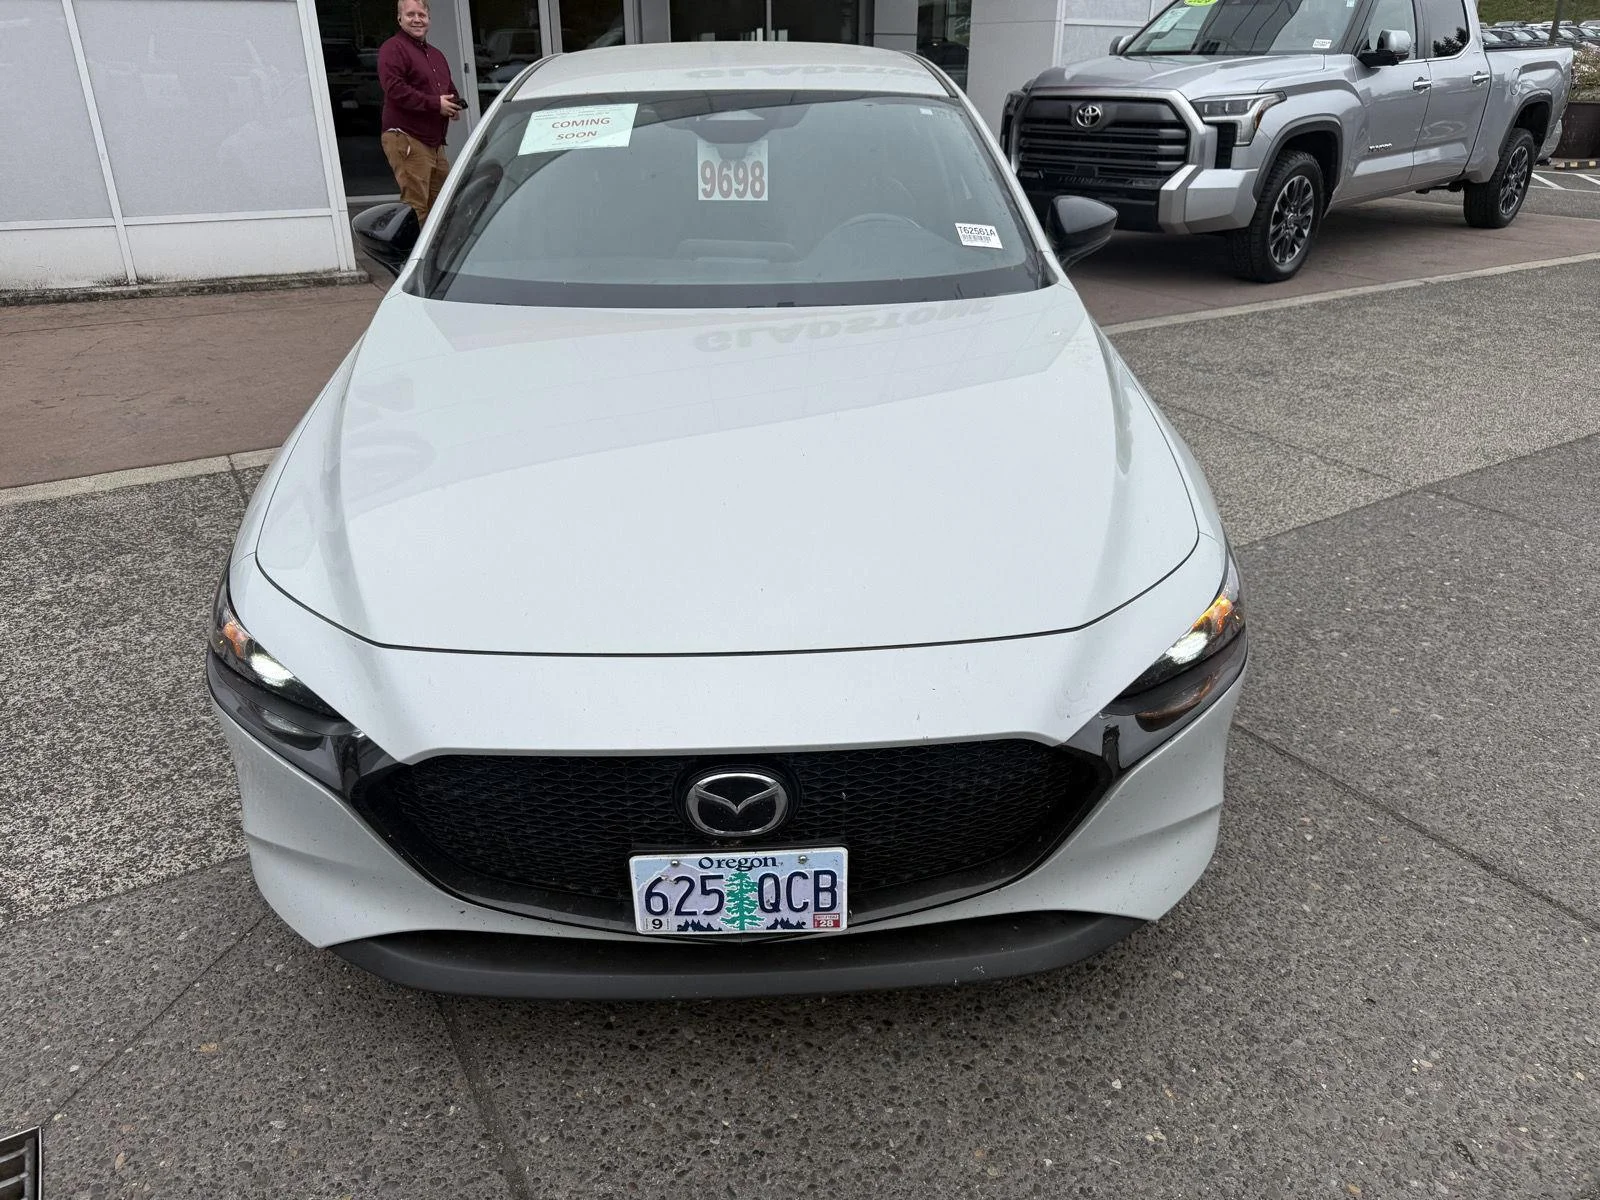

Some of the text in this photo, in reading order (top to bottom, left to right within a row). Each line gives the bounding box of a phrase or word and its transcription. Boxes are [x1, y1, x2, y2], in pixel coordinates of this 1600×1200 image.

[551, 117, 611, 129] COMING
[556, 130, 598, 141] SOON
[700, 159, 766, 199] 9698
[698, 856, 777, 872] Oregon
[644, 869, 838, 917] 625 QCB
[651, 918, 663, 930] 9
